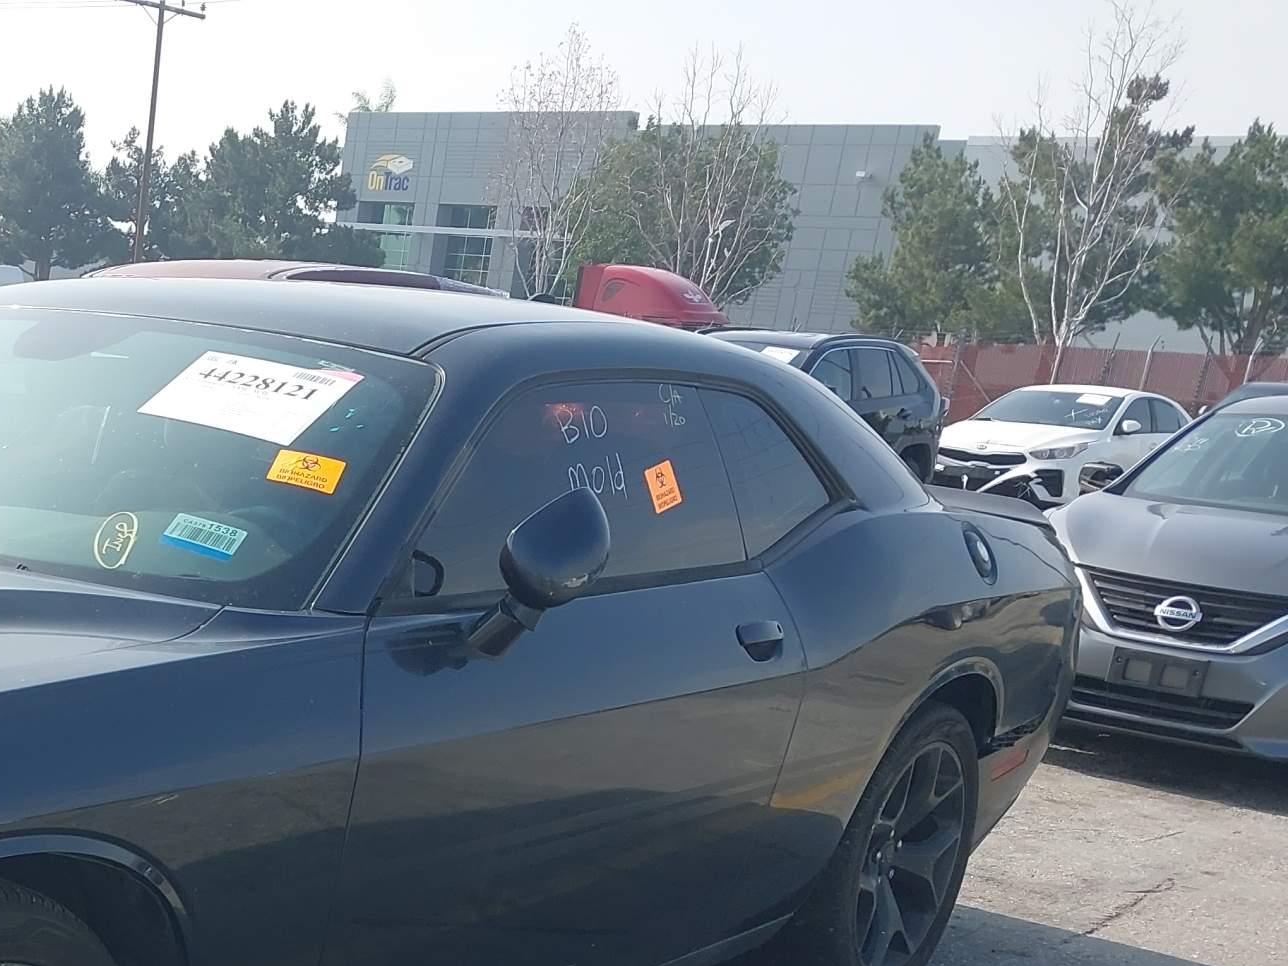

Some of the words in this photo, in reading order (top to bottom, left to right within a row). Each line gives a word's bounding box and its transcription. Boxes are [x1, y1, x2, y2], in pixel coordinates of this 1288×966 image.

[367, 170, 410, 191] OnTrac
[199, 367, 319, 400] 44228121
[555, 405, 608, 444] BIO
[1159, 608, 1197, 619] NISSAN
